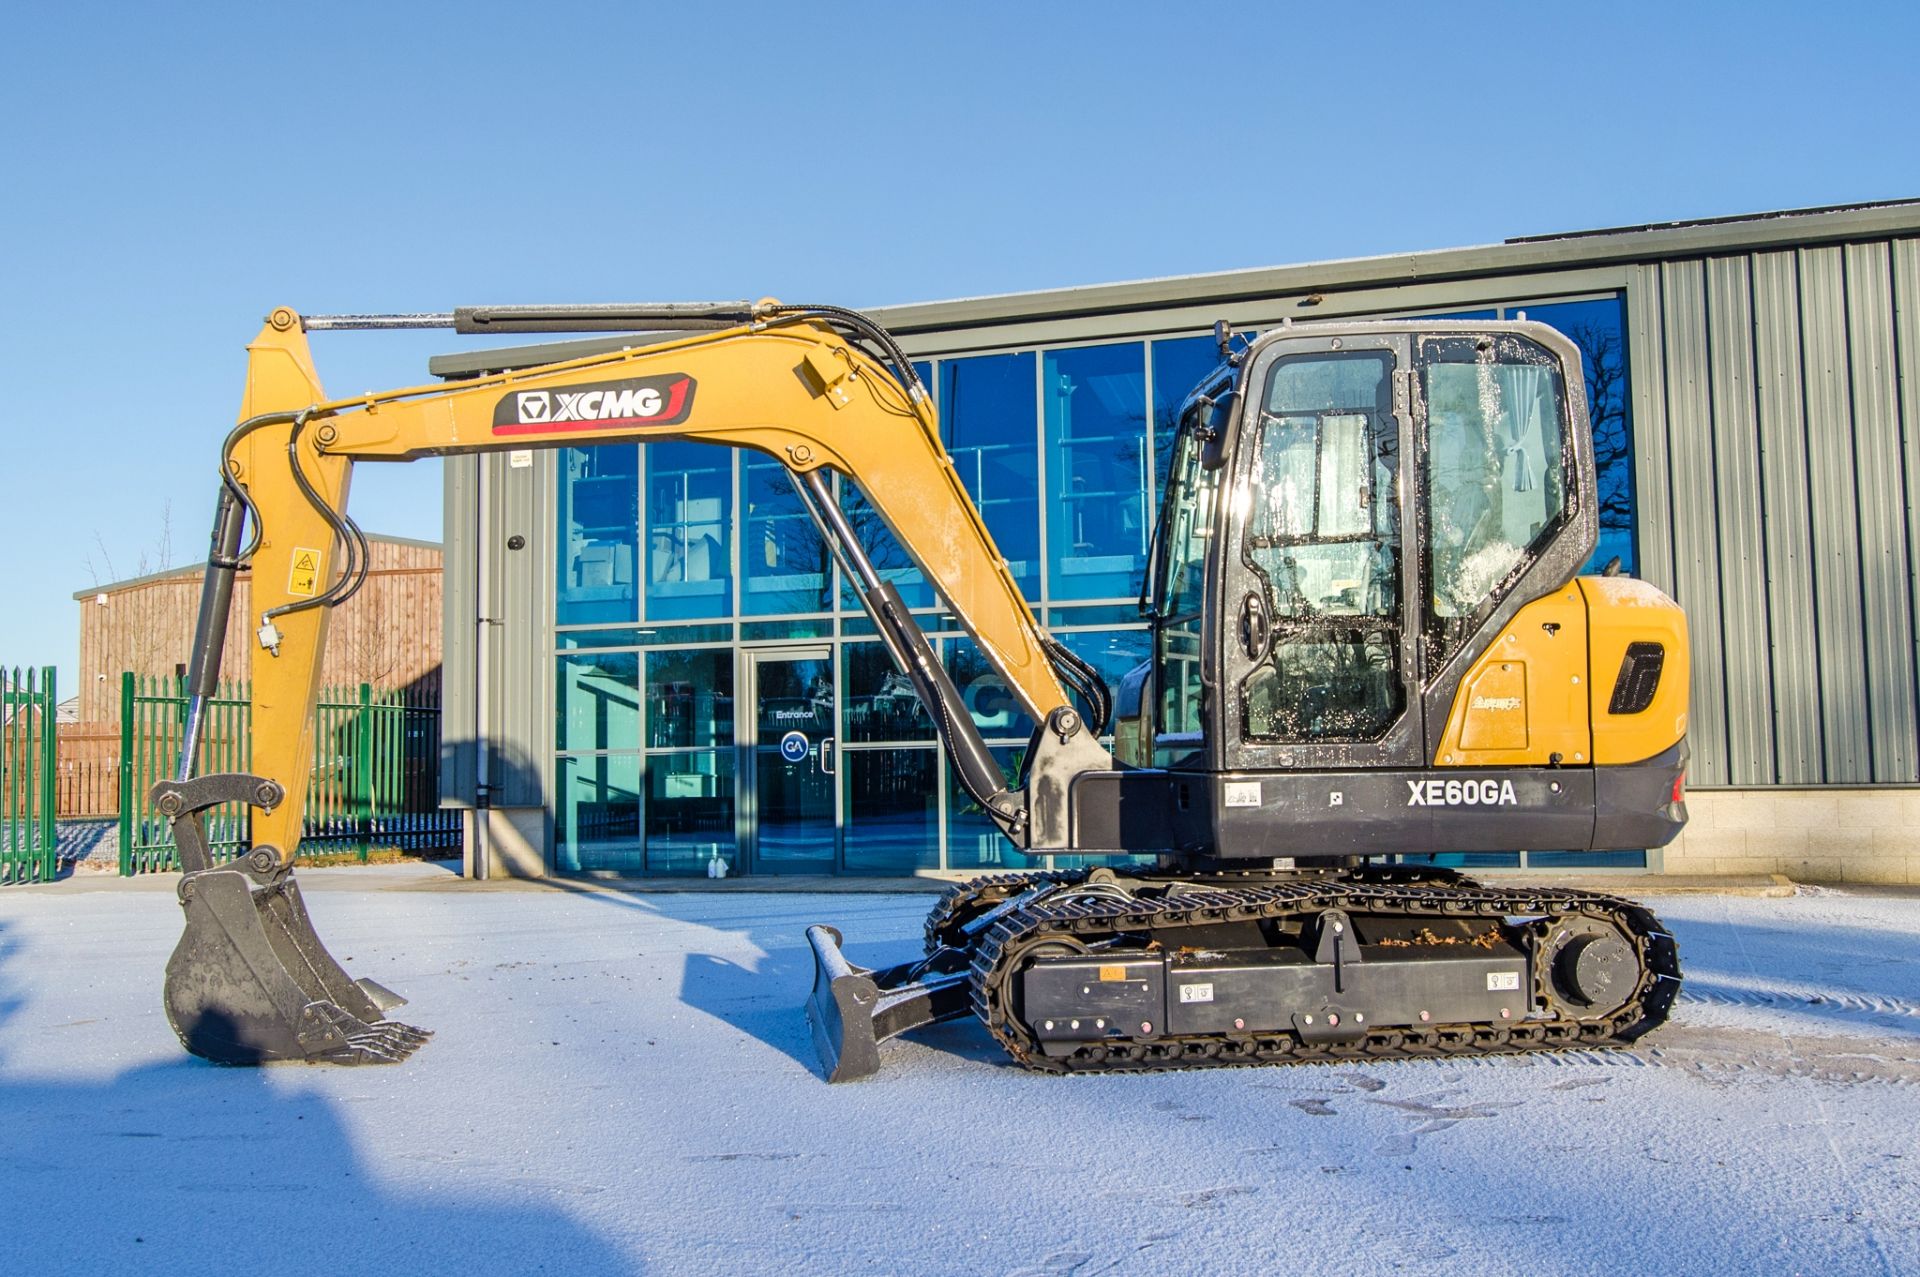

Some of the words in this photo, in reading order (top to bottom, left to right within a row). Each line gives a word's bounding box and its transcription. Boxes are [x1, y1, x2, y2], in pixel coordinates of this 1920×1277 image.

[551, 388, 662, 421] XCMG
[776, 711, 814, 719] Entrance
[1406, 779, 1518, 806] XE60GA
